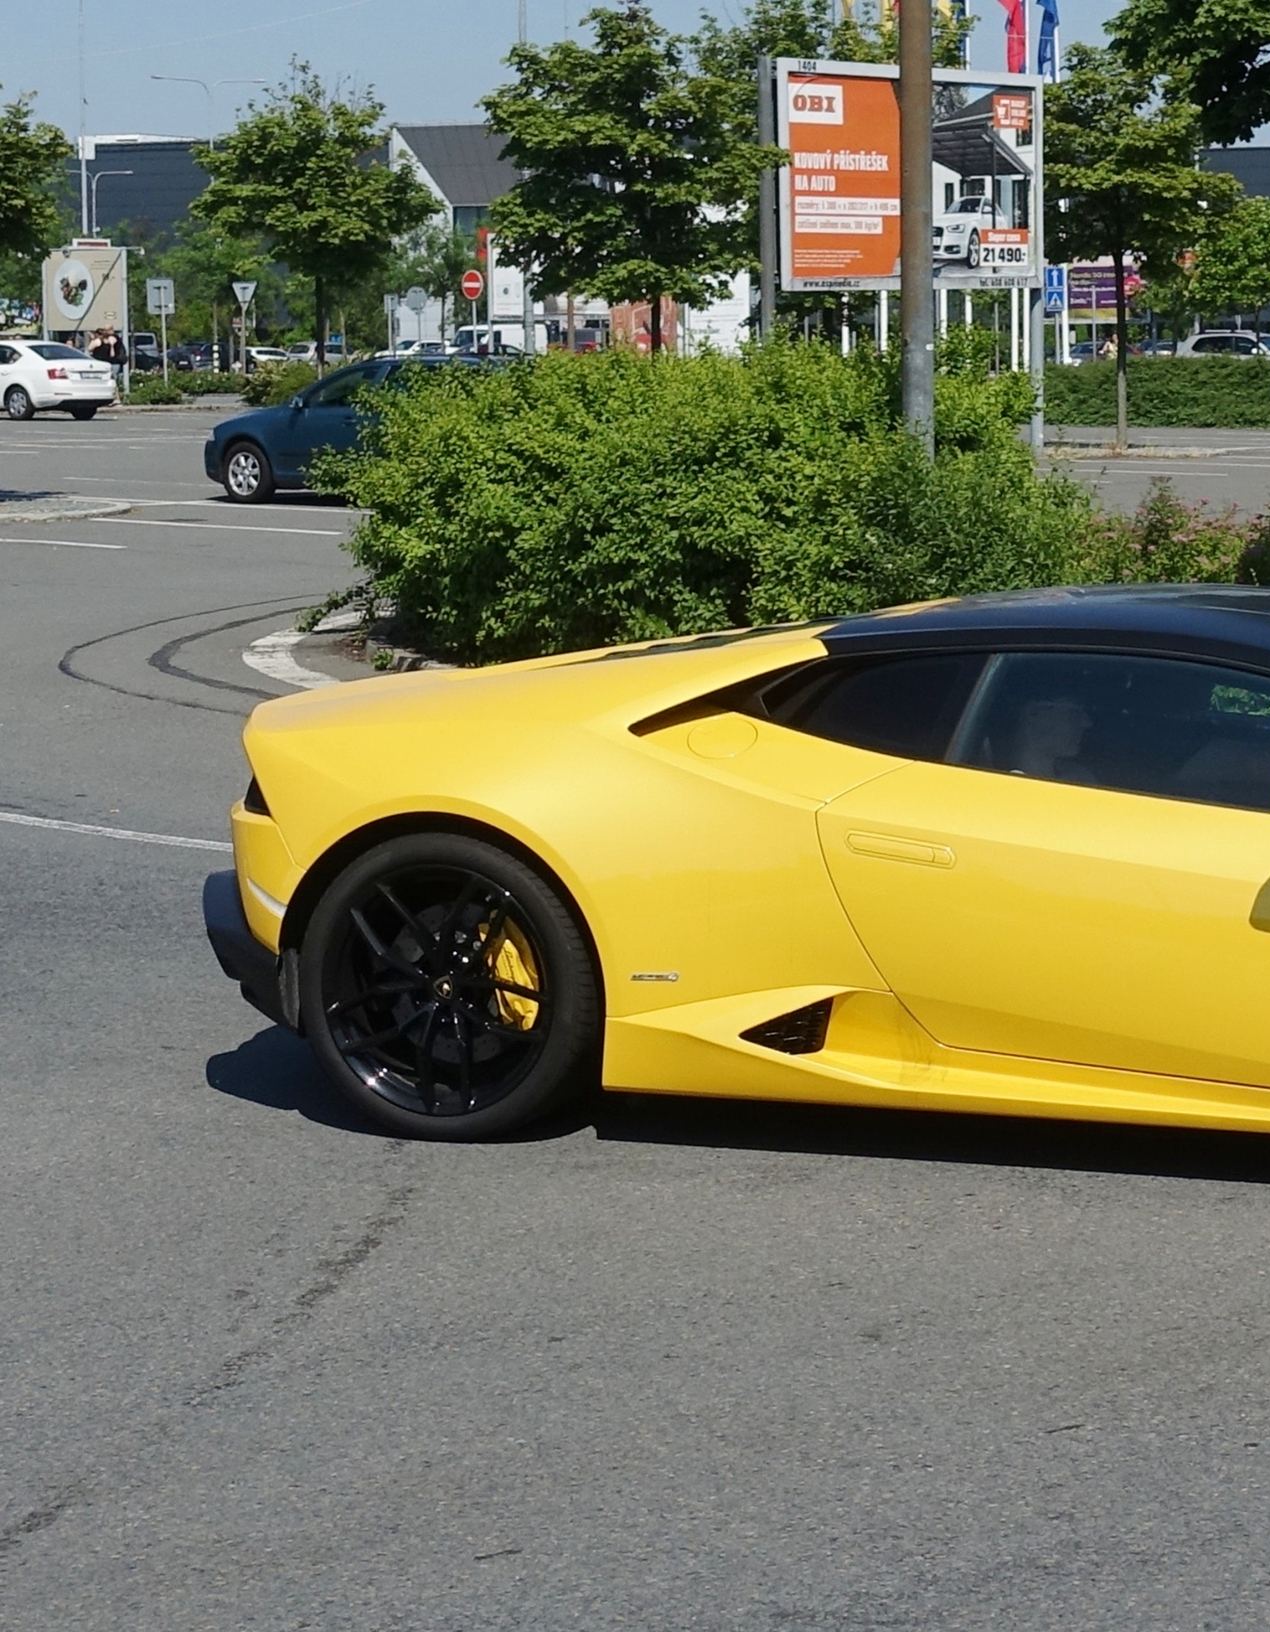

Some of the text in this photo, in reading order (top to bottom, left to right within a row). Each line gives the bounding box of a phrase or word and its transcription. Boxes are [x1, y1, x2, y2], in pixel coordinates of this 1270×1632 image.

[798, 60, 816, 71] 1404
[793, 94, 836, 113] OBI
[794, 149, 889, 171] KOVOVÝ PŘÍSTŘEŠEK
[794, 174, 836, 192] NA AUTO
[983, 247, 996, 262] 21
